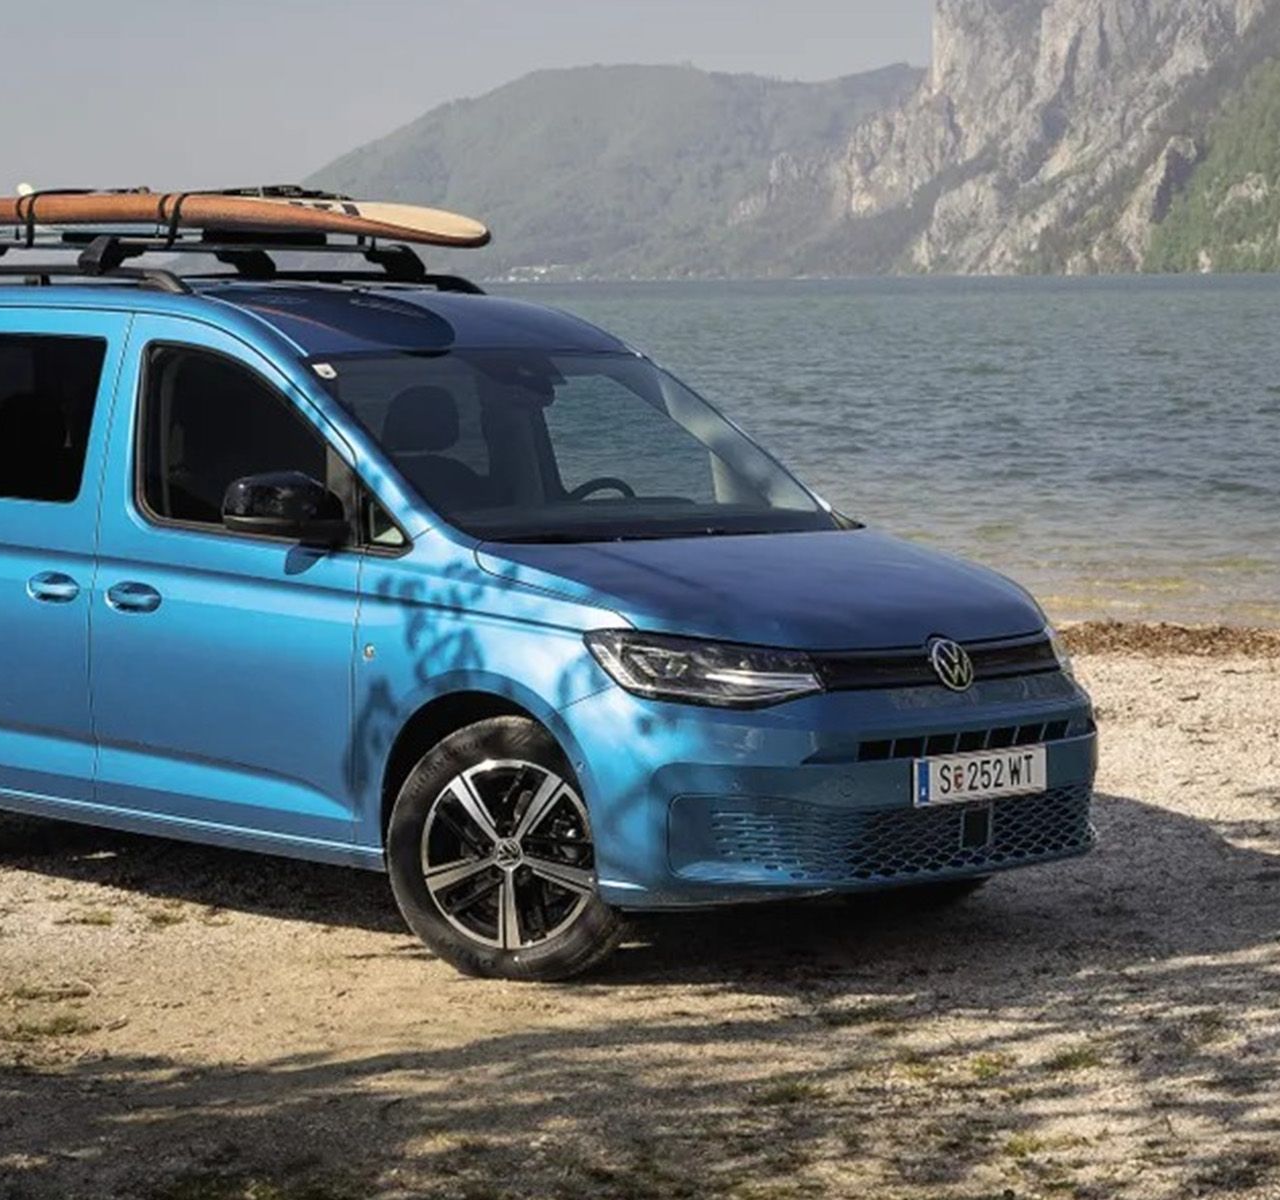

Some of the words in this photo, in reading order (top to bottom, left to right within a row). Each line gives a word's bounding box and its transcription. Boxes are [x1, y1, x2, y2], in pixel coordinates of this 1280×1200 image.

[939, 764, 951, 793] S
[967, 759, 1004, 791] 252
[1008, 754, 1033, 785] WT
